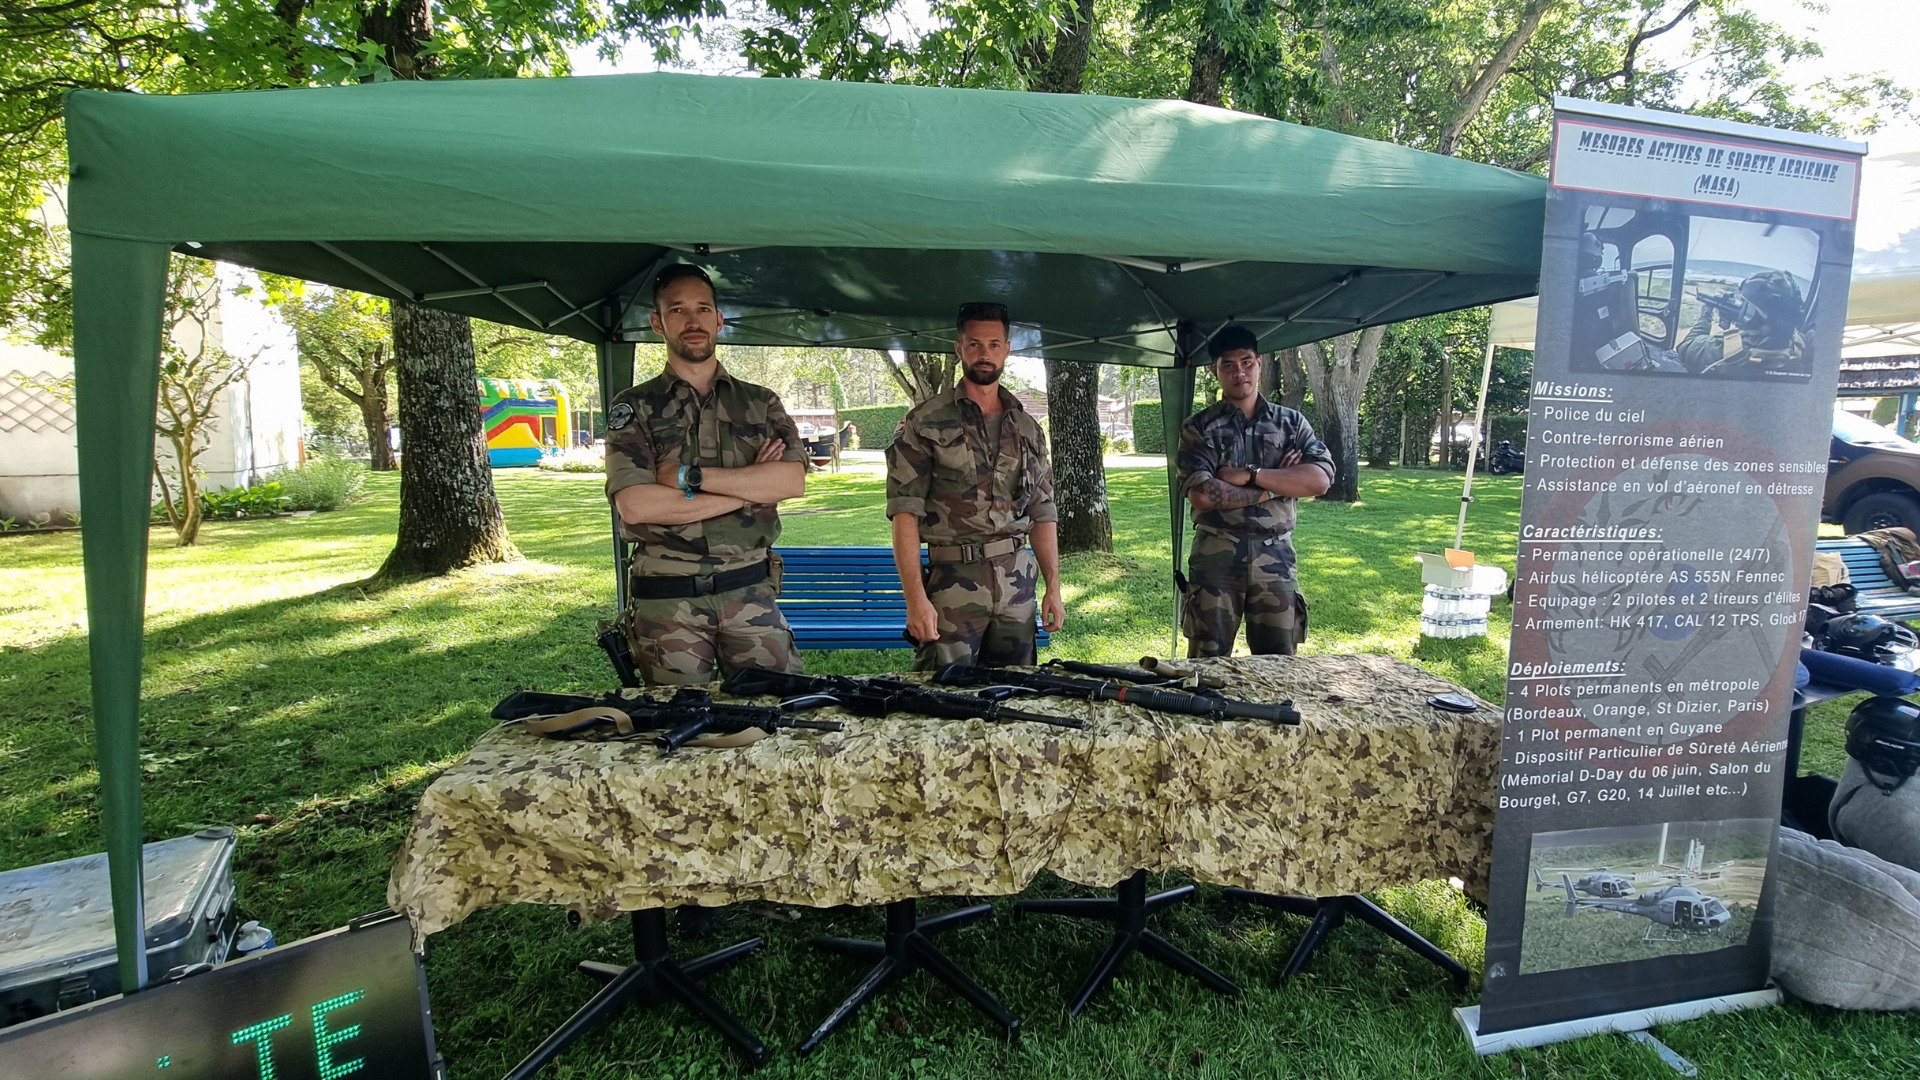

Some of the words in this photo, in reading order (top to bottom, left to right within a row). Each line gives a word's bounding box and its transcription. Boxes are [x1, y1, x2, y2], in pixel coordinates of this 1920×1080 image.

[1577, 131, 1644, 157] MESURES
[1647, 140, 1702, 165] ACTIVES
[1705, 148, 1724, 168] DE
[1726, 151, 1776, 174] SURETE
[1777, 157, 1839, 183] AERIENNE
[1694, 174, 1740, 199] (MASA)
[1533, 381, 1613, 399] Missions:
[1544, 406, 1589, 421] Police
[1595, 408, 1612, 422] du
[1618, 409, 1645, 423] ciel
[1542, 430, 1674, 447] Contre-terrorisme
[1679, 434, 1724, 448] aérien
[1540, 453, 1615, 469] Protection
[1621, 458, 1635, 469] et
[1641, 456, 1698, 471] défense
[1704, 458, 1729, 472] des
[1733, 461, 1774, 472] zones
[1778, 460, 1826, 474] sensibles
[1537, 478, 1617, 493] Assistance
[1623, 481, 1640, 493] en
[1647, 480, 1668, 493] vol
[1674, 480, 1741, 494] d'aéronef
[1745, 484, 1762, 495] en
[1767, 482, 1814, 495] détresse
[1522, 524, 1664, 541] Caractéristiques:
[1532, 548, 1623, 561] Permanence
[1629, 548, 1724, 563] opérationelle
[1729, 548, 1771, 563] (24/7)
[1528, 571, 1576, 584] Airbus
[1582, 571, 1664, 586] hélicoptére
[1668, 570, 1689, 583] AS
[1694, 570, 1731, 583] 555N
[1736, 571, 1785, 583] Fennec
[1528, 594, 1597, 609] Equipage
[1612, 593, 1621, 606] 2
[1626, 593, 1676, 608] pilotes
[1681, 594, 1695, 605] et
[1700, 592, 1709, 605] 2
[1713, 593, 1759, 605] tireurs
[1764, 592, 1801, 605] d'élites
[1525, 617, 1604, 630] Armement:
[1610, 615, 1632, 628] HK
[1637, 615, 1668, 629] 417,
[1674, 614, 1703, 627] CAL
[1709, 614, 1726, 627] 12
[1731, 613, 1764, 628] TPS,
[1769, 612, 1797, 625] Glock
[1510, 660, 1626, 678] Déploiements:
[1520, 685, 1529, 698] 4
[1535, 684, 1571, 697] Plots
[1577, 682, 1662, 698] permanents
[1667, 682, 1684, 693] en
[1689, 678, 1760, 693] métropole
[1507, 707, 1586, 723] (Bordeaux,
[1593, 703, 1650, 718] Orange,
[1656, 701, 1671, 714] St
[1676, 700, 1721, 714] Dizier,
[1727, 699, 1769, 713] Paris)
[1518, 730, 1524, 742] 1
[1531, 728, 1559, 741] Plot
[1564, 725, 1641, 742] permanent
[1647, 725, 1664, 736] en
[1669, 722, 1723, 737] Guyane
[1515, 748, 1584, 765] Dispositif
[1588, 745, 1663, 760] Particulier
[1667, 744, 1683, 755] de
[1688, 741, 1736, 754] Sûreté
[1501, 770, 1574, 789] (Mémorial
[1579, 768, 1624, 782] D-Day
[1629, 767, 1646, 779] du
[1652, 765, 1668, 777] 06
[1671, 763, 1702, 779] juin,
[1709, 762, 1749, 775] Salon
[1754, 762, 1771, 773] du
[1499, 793, 1561, 809] Bourget,
[1567, 790, 1591, 804] G7,
[1597, 788, 1631, 802] G20,
[1637, 787, 1654, 799] 14
[1659, 784, 1701, 798] Juillet
[1706, 782, 1748, 796] etc...)
